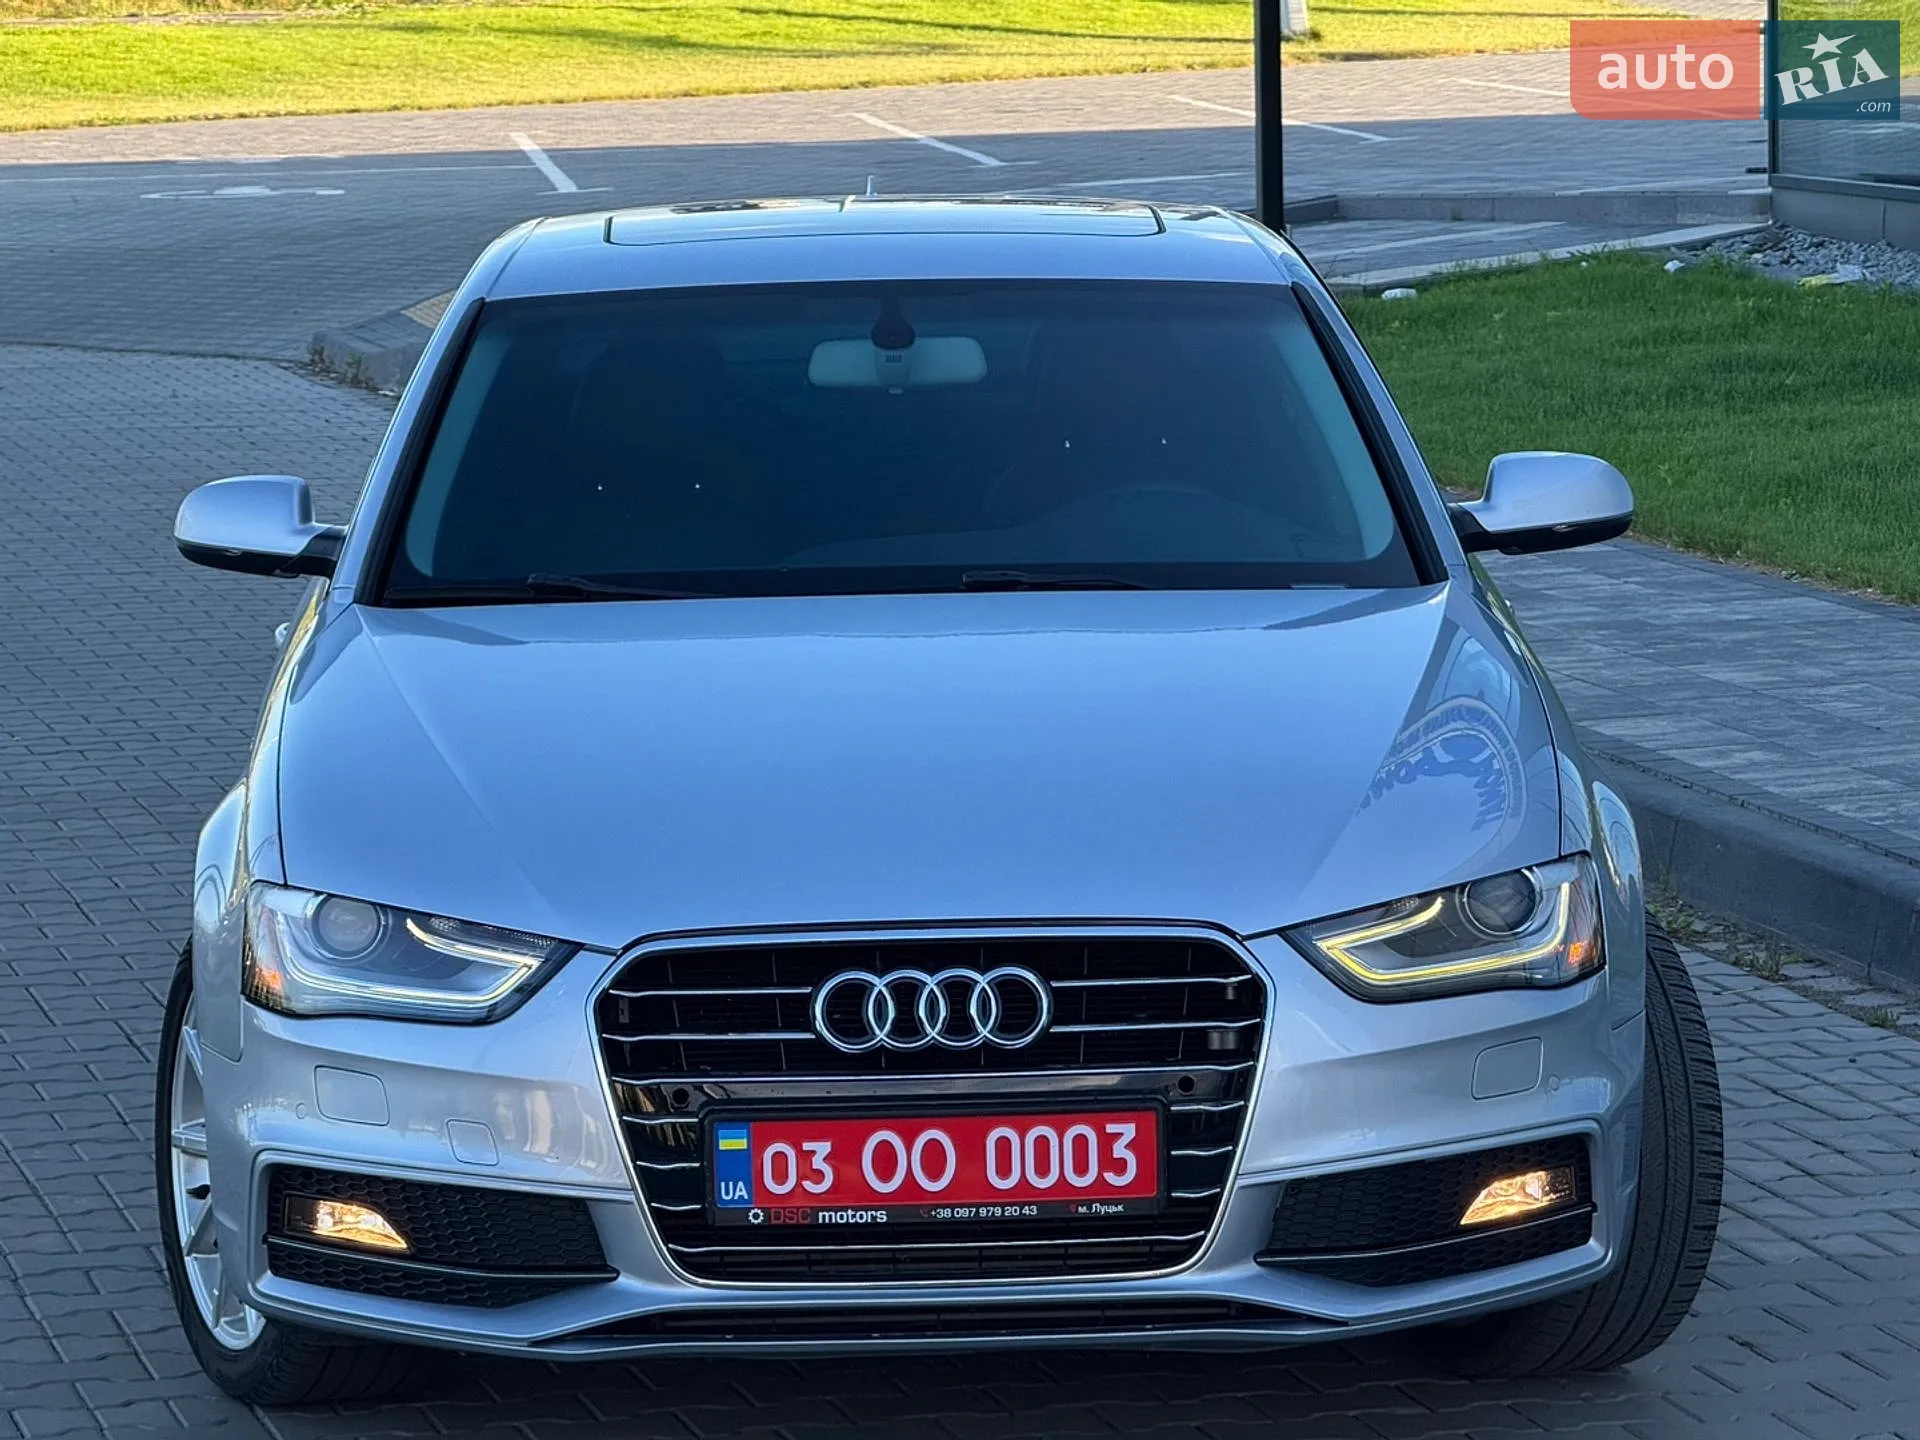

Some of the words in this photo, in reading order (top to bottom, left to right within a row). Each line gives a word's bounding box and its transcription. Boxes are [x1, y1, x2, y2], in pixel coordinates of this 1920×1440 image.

[762, 1141, 835, 1195] 03
[985, 1122, 1138, 1190] 0003
[720, 1181, 748, 1200] UA
[770, 1208, 811, 1224] DSC
[818, 1208, 888, 1224] motors
[930, 1208, 951, 1219] +38
[954, 1207, 976, 1218] 097
[979, 1207, 1001, 1217] 979
[1004, 1206, 1020, 1216] 20
[1022, 1205, 1038, 1216] 43
[1091, 1203, 1125, 1215] Луцьк
